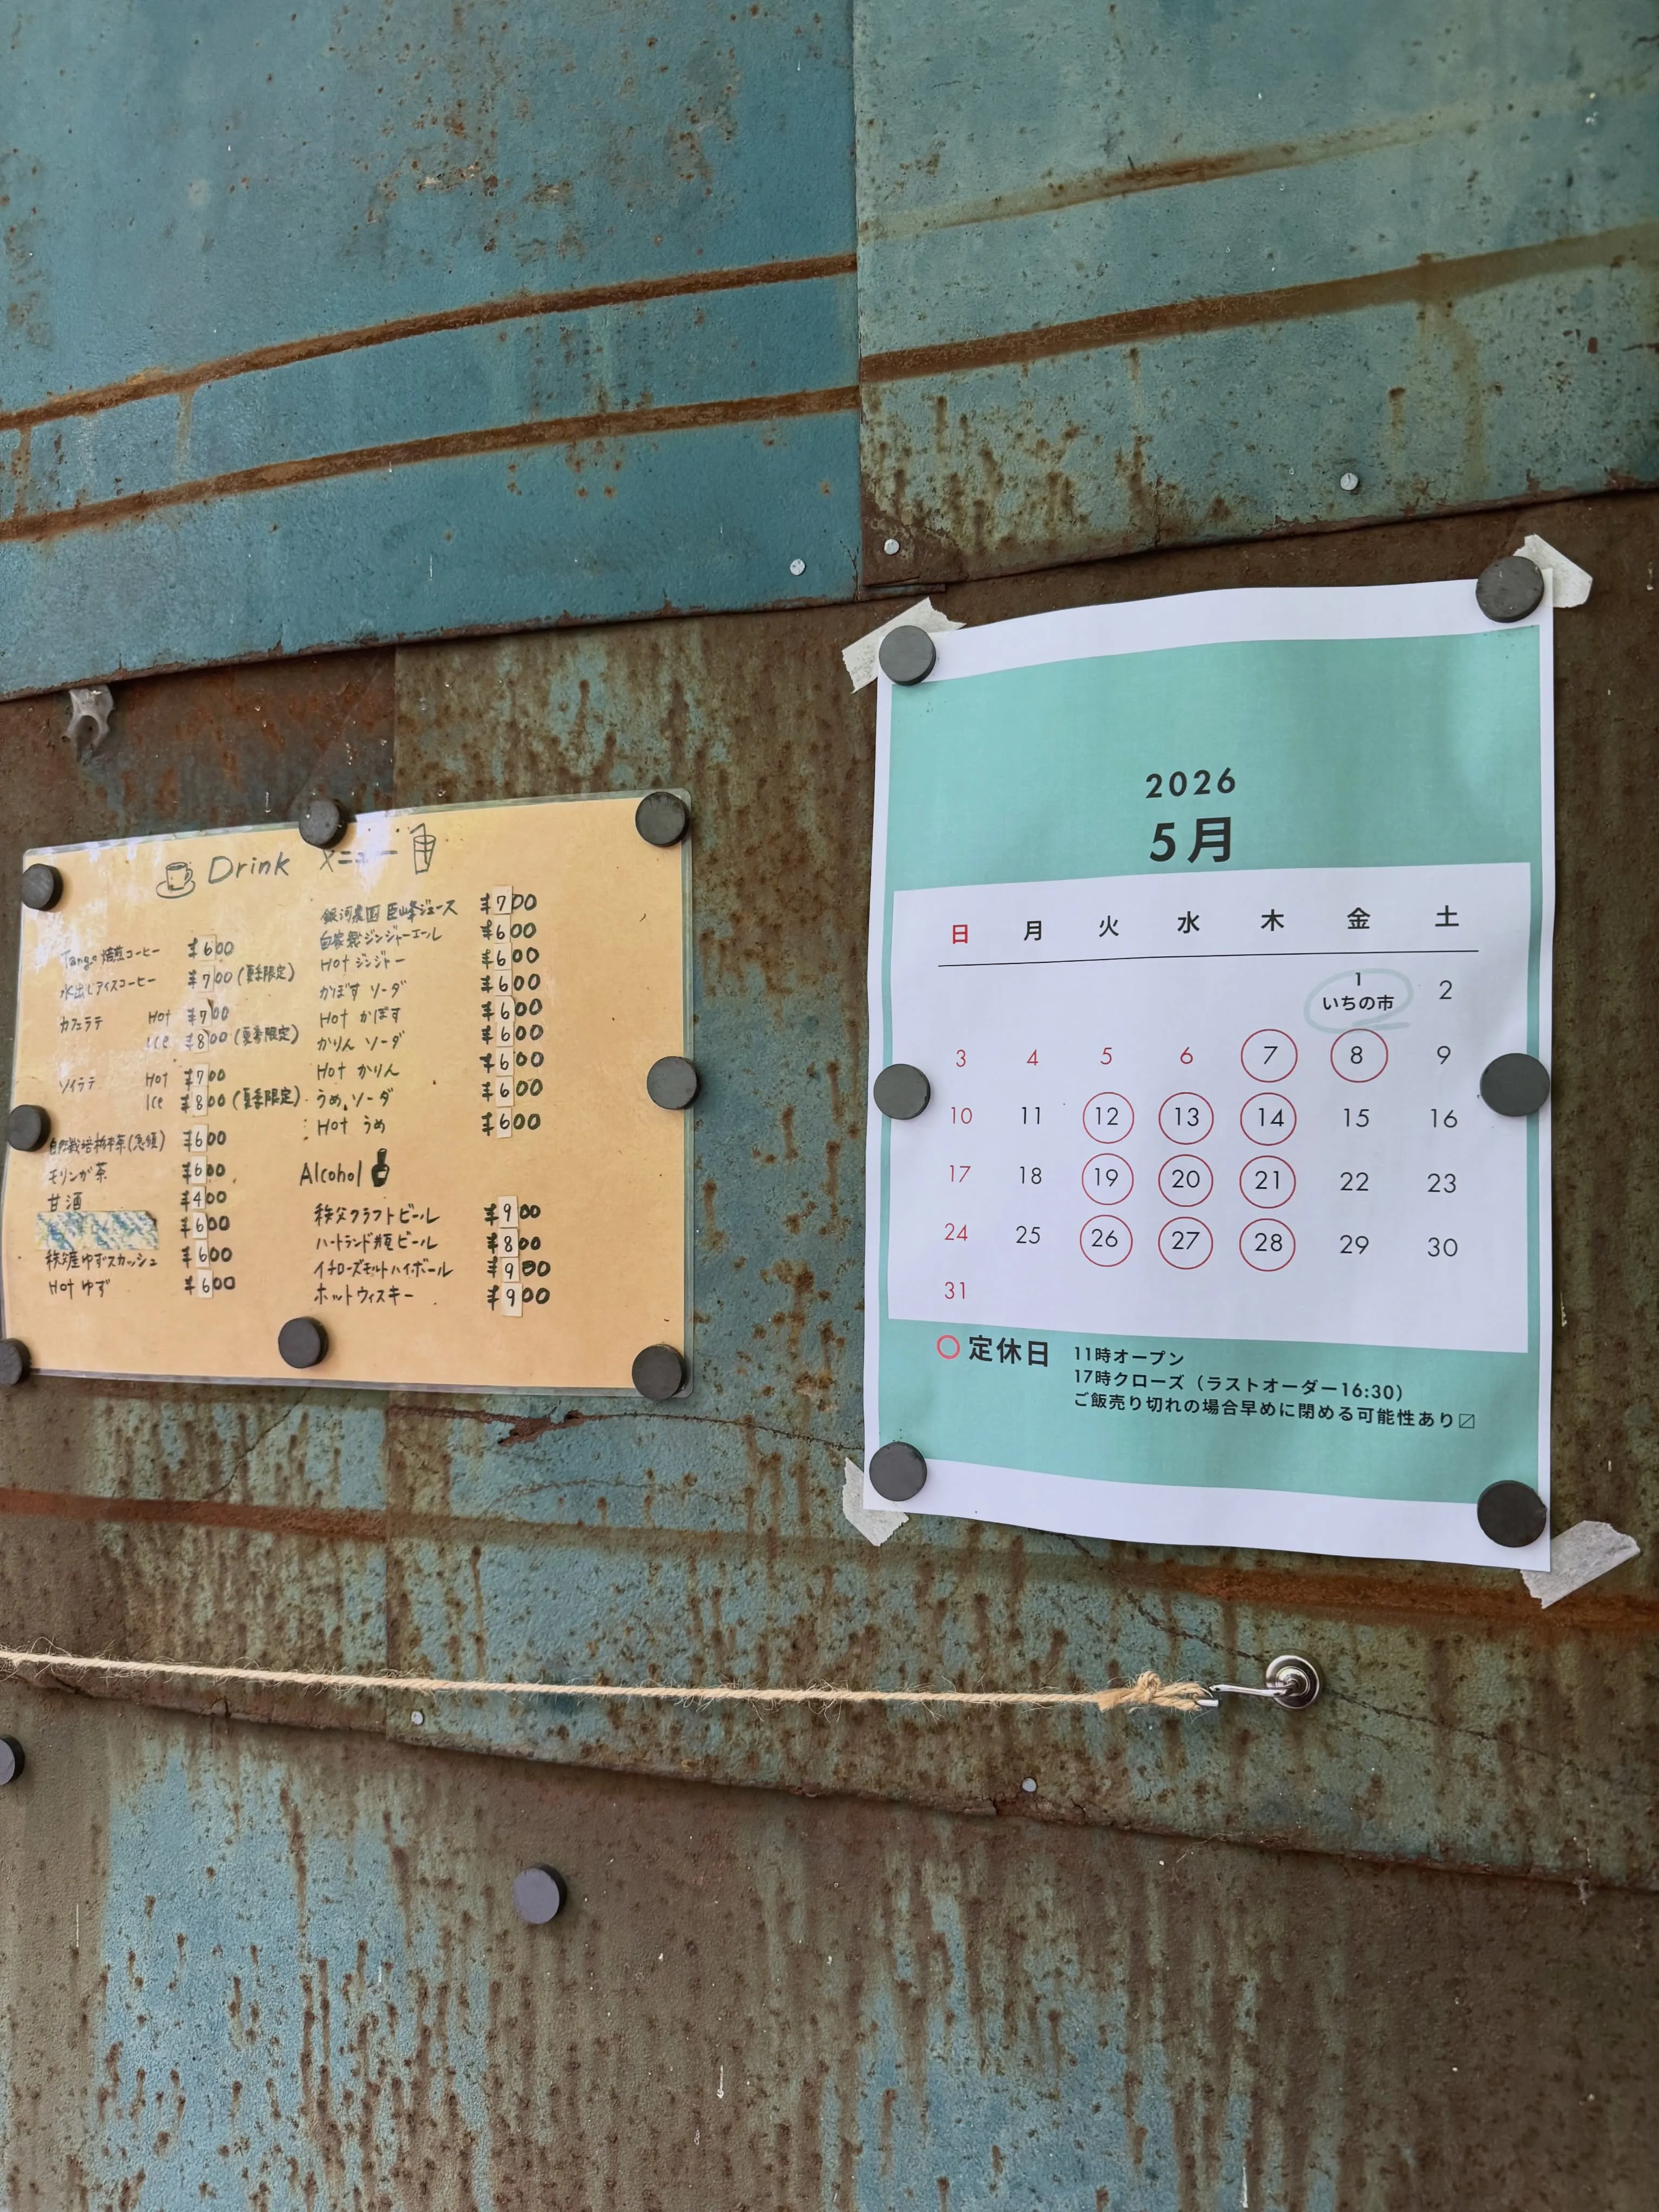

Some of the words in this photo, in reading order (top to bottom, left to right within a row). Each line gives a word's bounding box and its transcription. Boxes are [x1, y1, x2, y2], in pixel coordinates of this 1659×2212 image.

[1145, 767, 1236, 799] 2026
[1149, 817, 1231, 864] 5月
[207, 851, 289, 884] Drink
[480, 893, 537, 915] ¥700
[480, 919, 537, 940] ¥600
[952, 924, 968, 945] 日
[1023, 920, 1042, 941] 月
[1098, 915, 1120, 938] 火
[1177, 911, 1200, 934] 水
[1260, 909, 1285, 932] 木
[1347, 907, 1371, 929] 金
[1435, 905, 1459, 927] 土
[102, 945, 160, 965] 焙煎コーヒー
[187, 937, 234, 960] ¥600
[321, 954, 349, 972] Hot
[356, 950, 406, 969] ジンジャー
[482, 947, 539, 969] ¥600
[60, 976, 156, 1000] 水出しアイスコーヒー
[188, 969, 233, 989] ¥700
[320, 982, 360, 1001] かぼす
[370, 981, 407, 999] ソーダ
[481, 974, 541, 993] ¥600
[1355, 972, 1361, 986] 1
[1439, 980, 1452, 1000] 2
[320, 1009, 348, 1029] Hot
[360, 1006, 401, 1024] かぼす
[482, 998, 543, 1021] ¥600
[1323, 994, 1394, 1011] いちの市
[60, 1016, 103, 1034] カフェラテ
[149, 1009, 172, 1027] Hot
[187, 1006, 229, 1026] ¥700
[185, 1031, 228, 1050] ¥800
[318, 1036, 355, 1052] かりん
[366, 1030, 405, 1051] ソーダ
[482, 1024, 544, 1045] ¥600
[318, 1062, 346, 1081] Hot
[358, 1064, 400, 1080] かりん
[480, 1051, 544, 1073] ¥600
[956, 1049, 966, 1068] 3
[1026, 1049, 1038, 1066] 4
[1100, 1047, 1112, 1065] 5
[1180, 1047, 1193, 1064] 6
[1264, 1046, 1278, 1064] 7
[1350, 1045, 1363, 1064] 8
[1437, 1046, 1451, 1065] 9
[58, 1076, 95, 1094] ソイラテ
[146, 1071, 168, 1088] Hot
[184, 1068, 226, 1091] ¥700
[316, 1089, 342, 1108] うめ
[352, 1088, 393, 1107] ソーダ
[482, 1078, 543, 1102] ¥600
[180, 1094, 226, 1114] ¥800
[233, 1085, 301, 1111] (夏季限定)
[318, 1117, 348, 1136] Hot
[364, 1115, 386, 1134] うめ
[482, 1112, 541, 1136] ¥600
[951, 1107, 973, 1124] 10
[1022, 1107, 1040, 1125] 11
[1096, 1107, 1118, 1125] 12
[1175, 1107, 1199, 1127] 13
[1258, 1108, 1285, 1127] 14
[1344, 1108, 1370, 1128] 15
[1431, 1109, 1458, 1128] 16
[183, 1130, 226, 1152] ¥600
[182, 1162, 226, 1184] ¥600
[300, 1161, 362, 1186] Alcohol
[949, 1165, 972, 1183] 17
[1020, 1166, 1042, 1185] 18
[1095, 1168, 1118, 1187] 19
[1172, 1169, 1200, 1188] 20
[1255, 1170, 1279, 1190] 21
[1340, 1172, 1368, 1191] 22
[1427, 1173, 1456, 1193] 23
[48, 1192, 83, 1212] 甘酒
[181, 1190, 227, 1212] ¥400
[180, 1215, 230, 1238] ¥600
[314, 1203, 440, 1226] 秩父クラフトビール
[484, 1203, 541, 1226] ¥900
[316, 1231, 439, 1253] ハートランド瓶ビール
[487, 1232, 541, 1254] ¥800
[945, 1223, 968, 1241] 24
[1016, 1225, 1041, 1244] 25
[1091, 1229, 1118, 1247] 26
[1172, 1231, 1201, 1250] 27
[1254, 1233, 1284, 1252] 28
[1340, 1235, 1369, 1255] 29
[1427, 1237, 1458, 1257] 30
[181, 1245, 232, 1268] ¥600
[487, 1256, 551, 1278] ¥900
[49, 1279, 74, 1300] Hot
[82, 1278, 111, 1297] ゆず
[185, 1276, 235, 1295] ¥600
[314, 1283, 414, 1306] ホットウィスキー
[487, 1285, 550, 1311] ¥900
[945, 1282, 965, 1299] 31
[968, 1335, 1049, 1368] 定休日
[1074, 1346, 1185, 1366] 11時オープン
